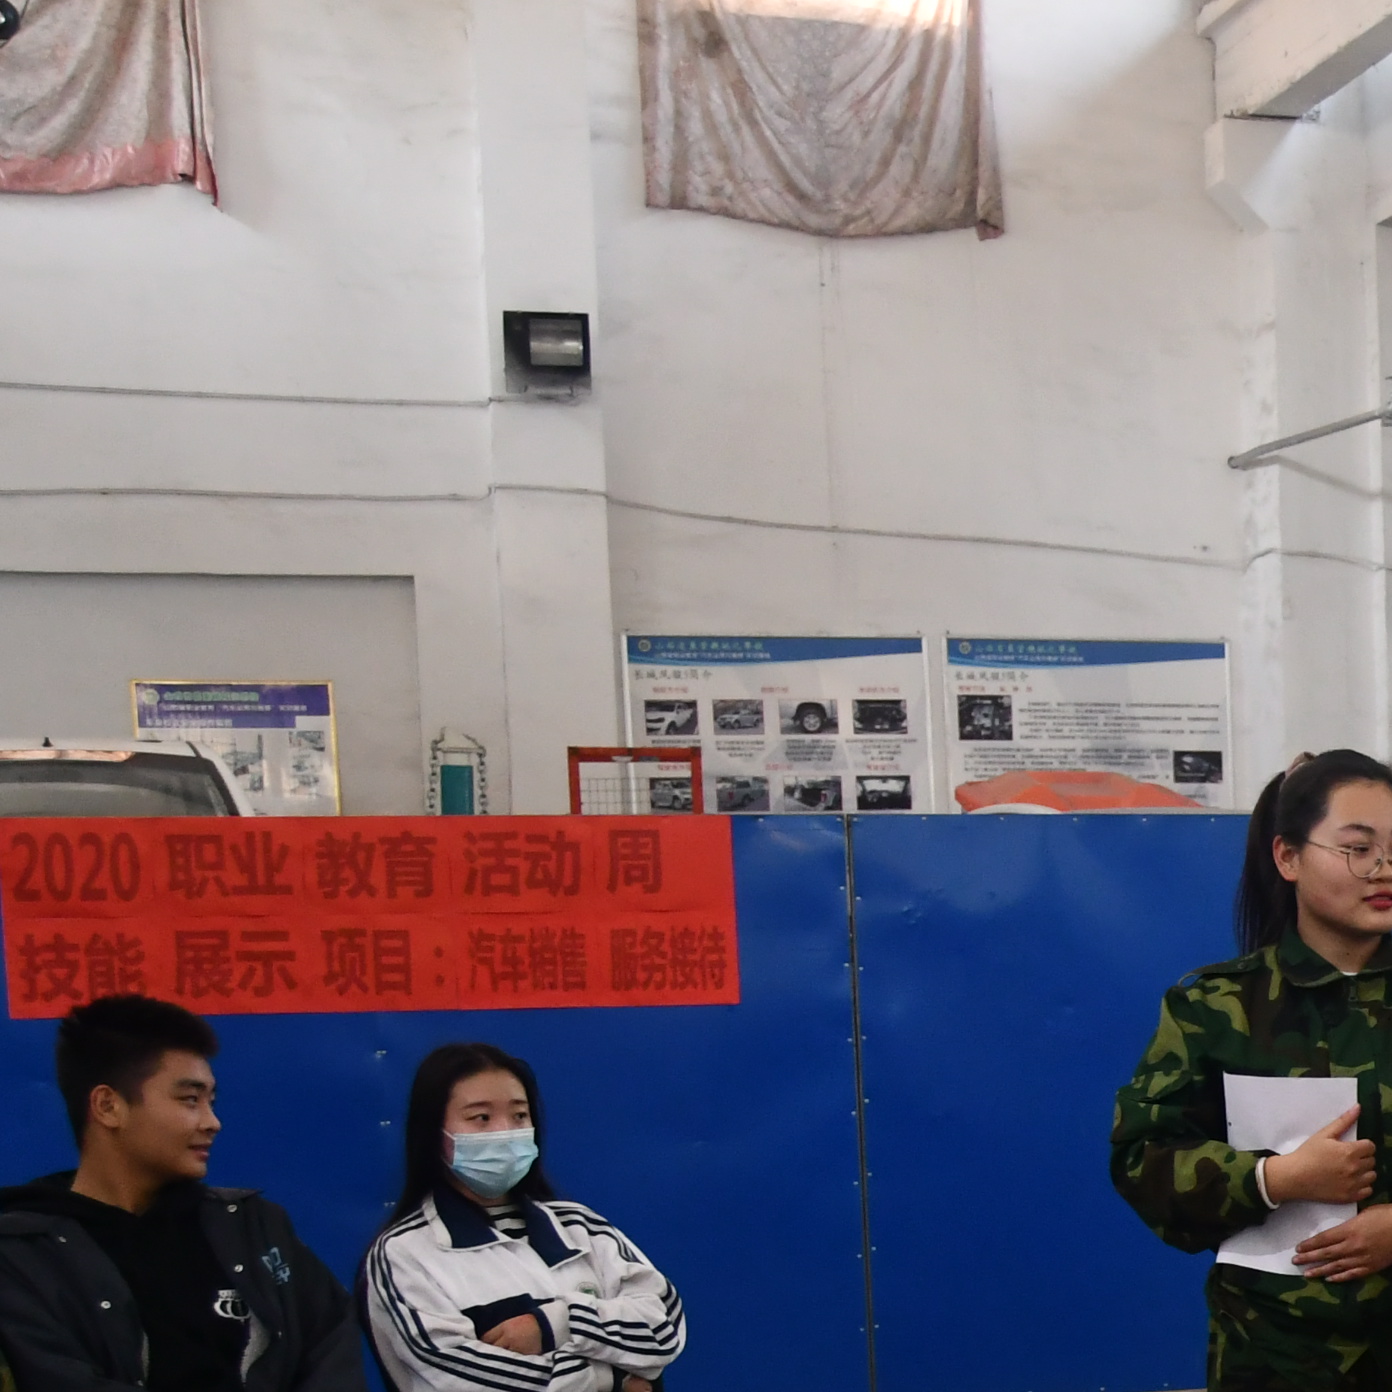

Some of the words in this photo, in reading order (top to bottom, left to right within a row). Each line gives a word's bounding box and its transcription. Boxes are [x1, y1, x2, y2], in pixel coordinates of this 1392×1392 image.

[12, 831, 142, 903] 2020
[164, 830, 295, 900] 职业
[314, 830, 438, 900] 教育
[462, 829, 583, 897] 活动
[605, 828, 663, 895] 周
[18, 932, 148, 1003] 技能
[174, 930, 298, 999] 展示
[468, 925, 588, 993] 汽车销售
[609, 924, 729, 992] 服务接待
